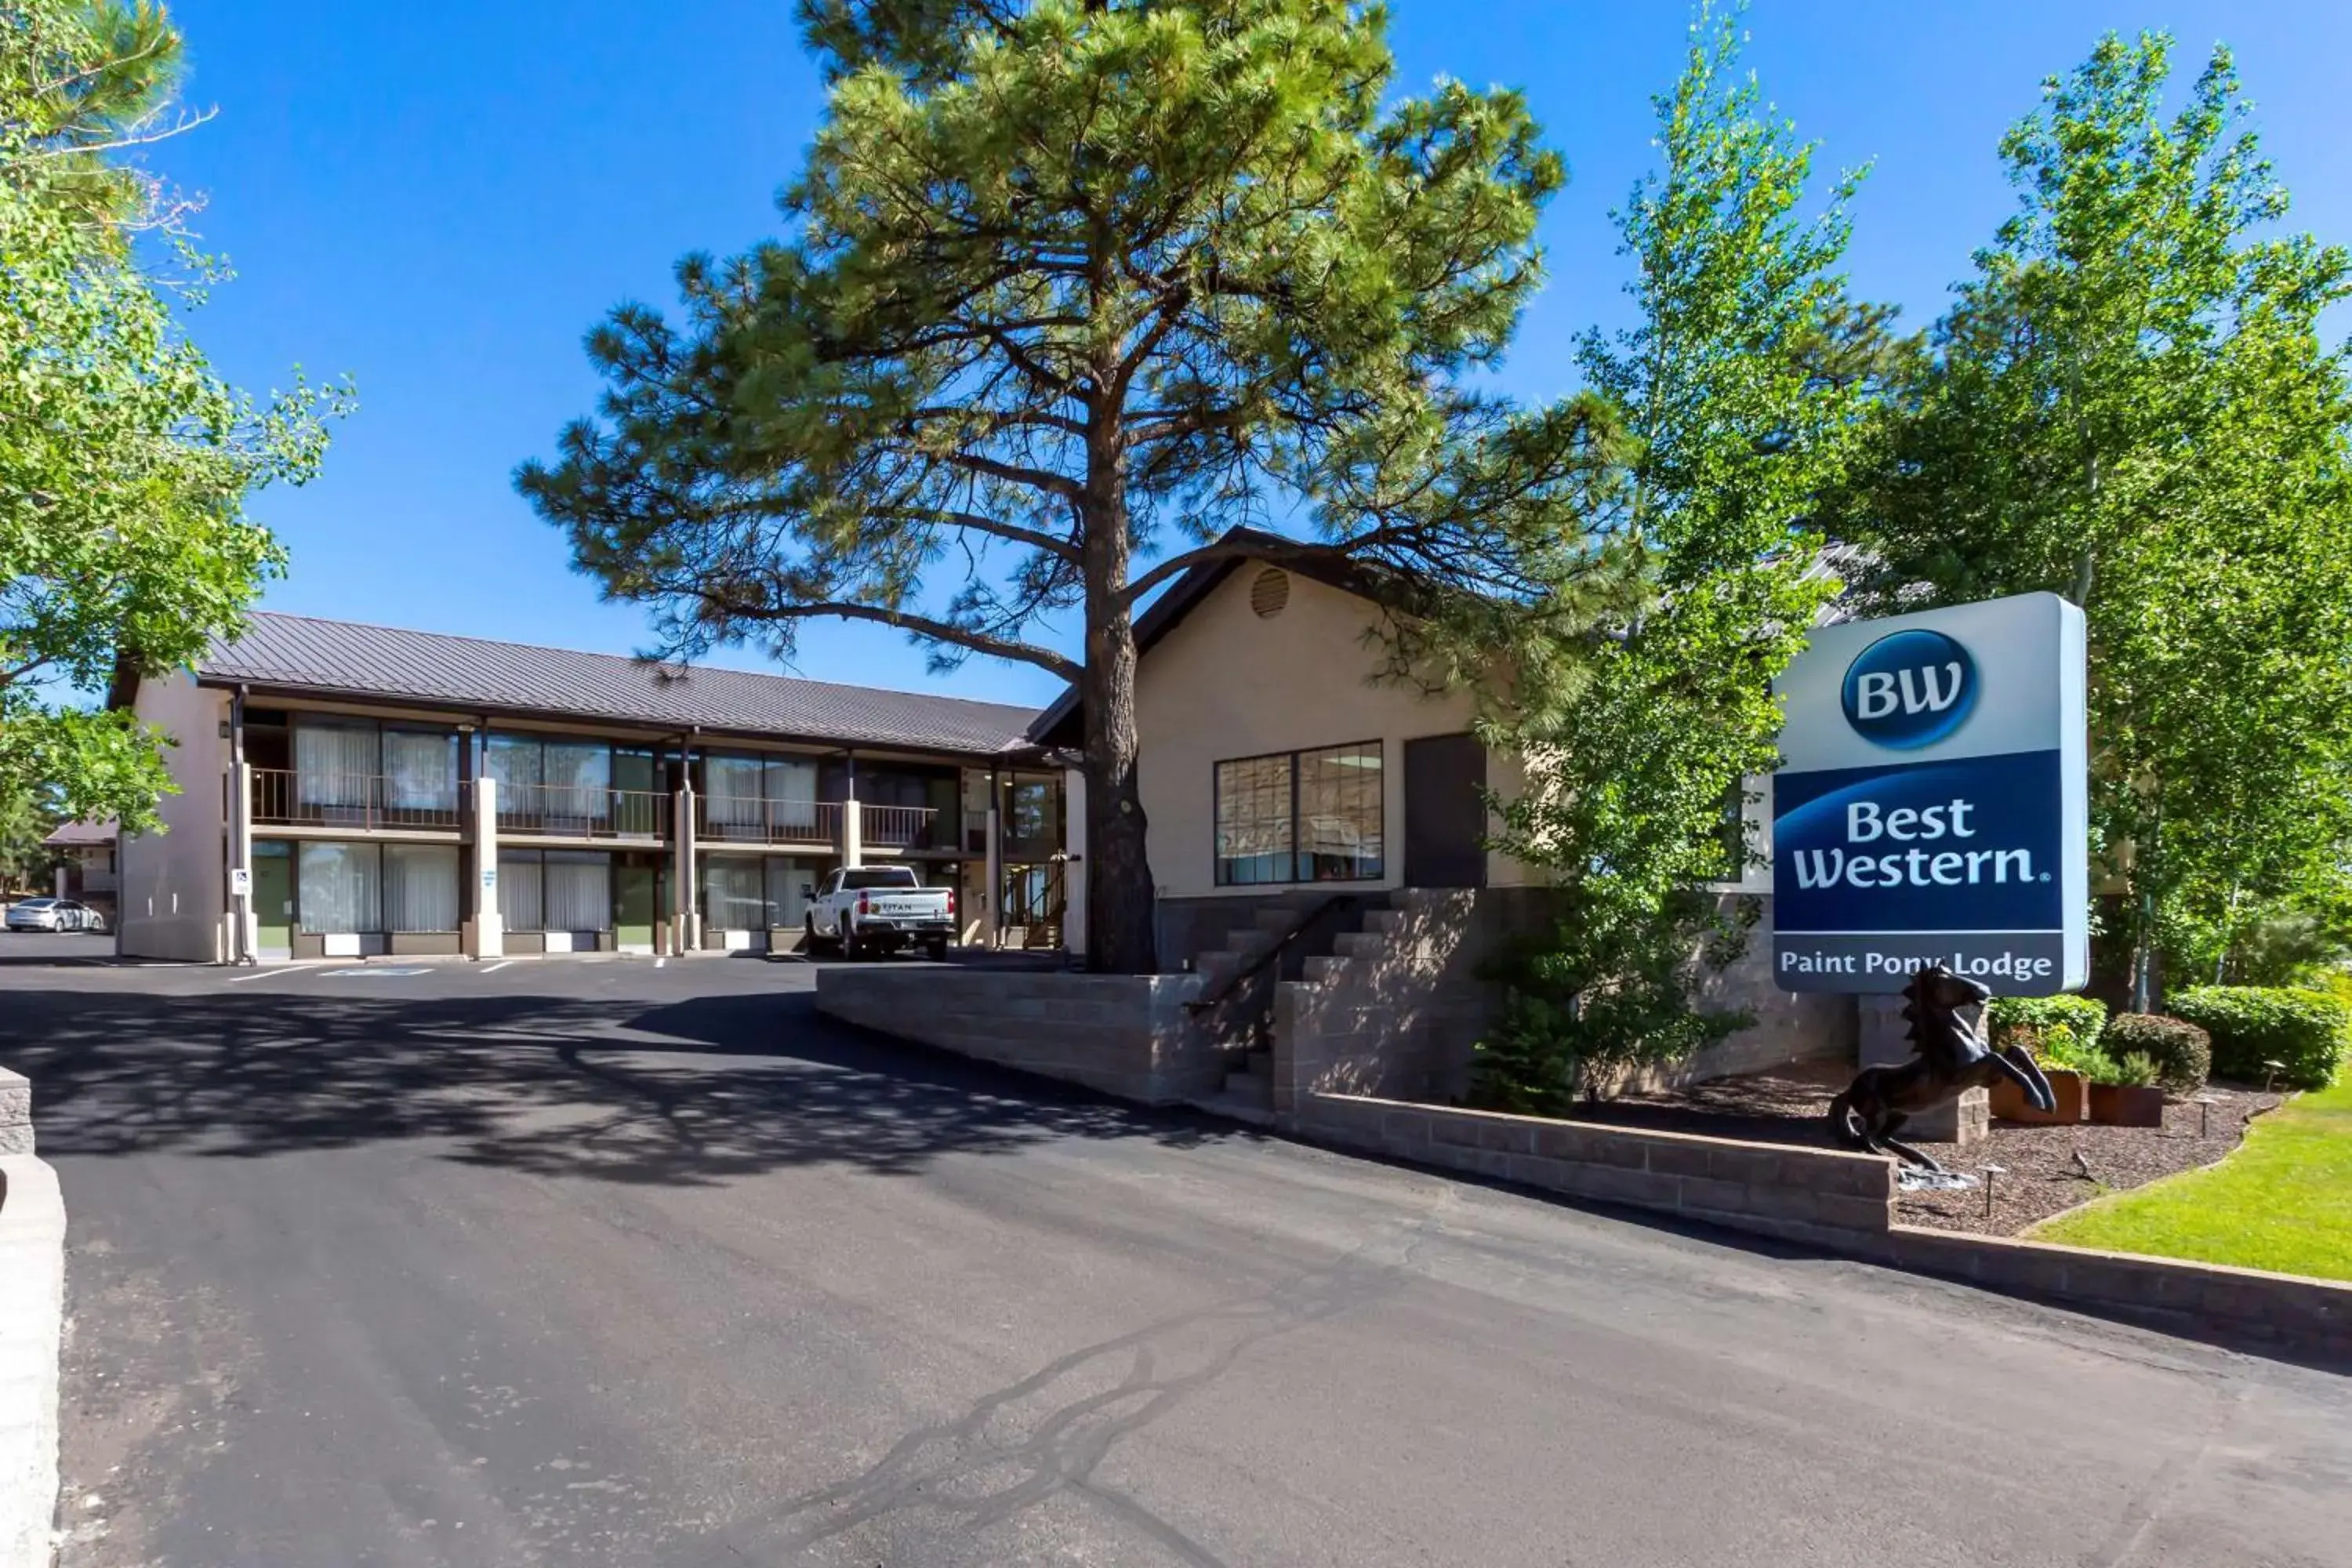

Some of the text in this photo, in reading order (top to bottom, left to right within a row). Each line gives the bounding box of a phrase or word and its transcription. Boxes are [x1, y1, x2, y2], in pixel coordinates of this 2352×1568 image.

[1857, 661, 1962, 720] BW
[1846, 798, 1976, 843] Best
[1792, 846, 2035, 890] Western
[1780, 951, 1857, 974] Paint
[1955, 951, 2053, 982] Lodge
